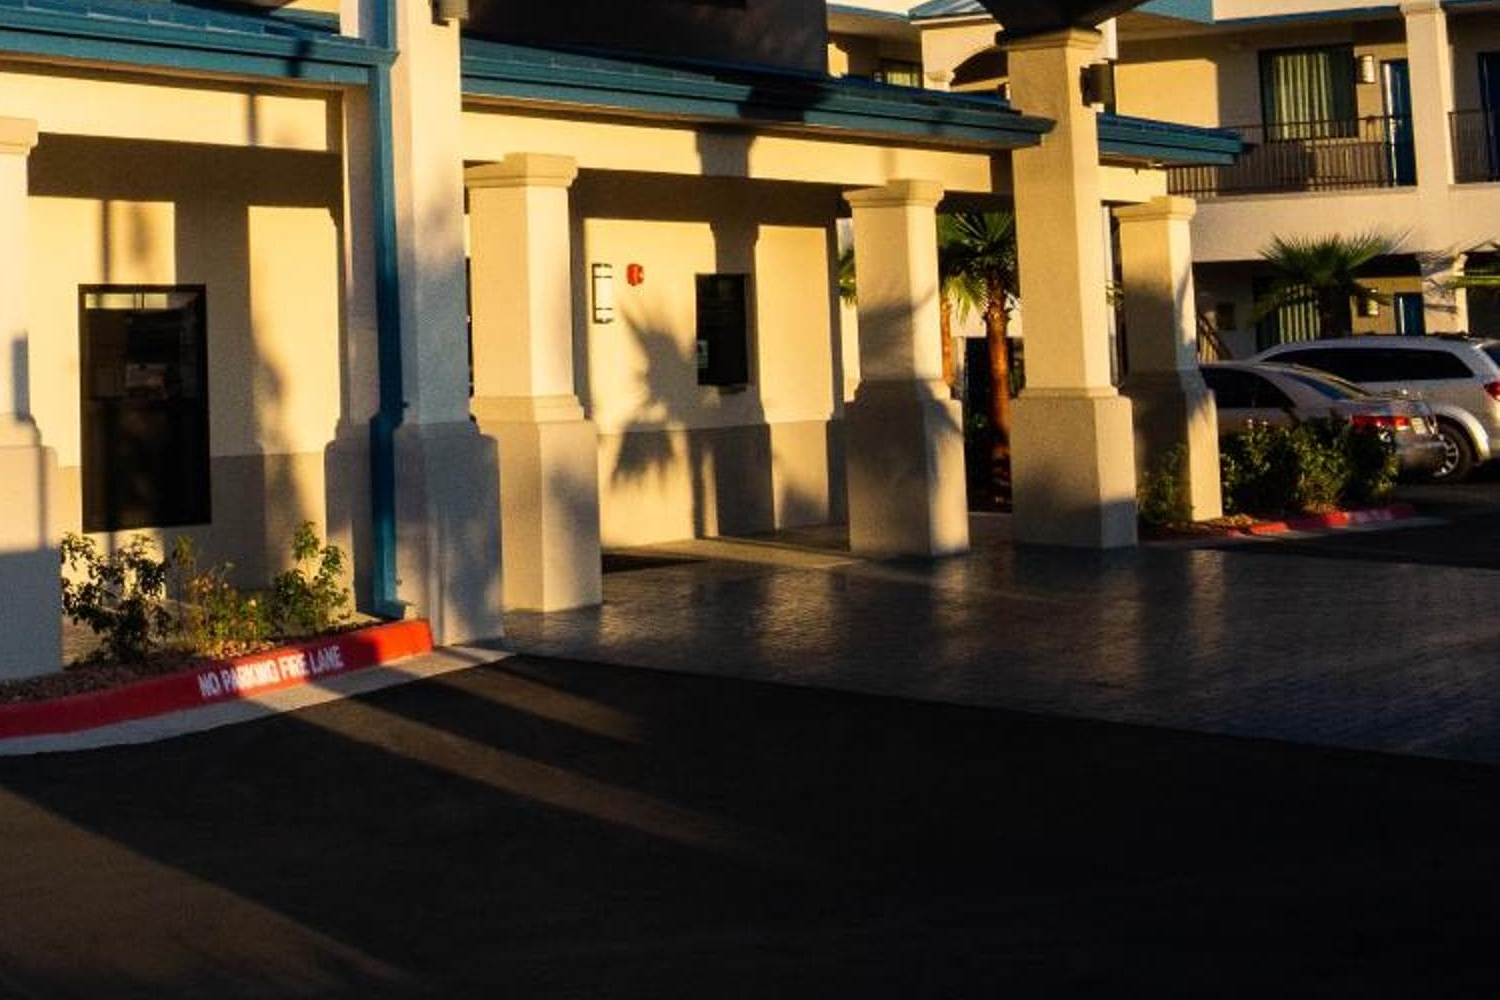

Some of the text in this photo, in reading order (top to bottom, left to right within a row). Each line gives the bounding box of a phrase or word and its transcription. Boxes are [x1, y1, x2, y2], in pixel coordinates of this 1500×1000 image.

[197, 645, 344, 696] NO PARKING FIRE LANE
